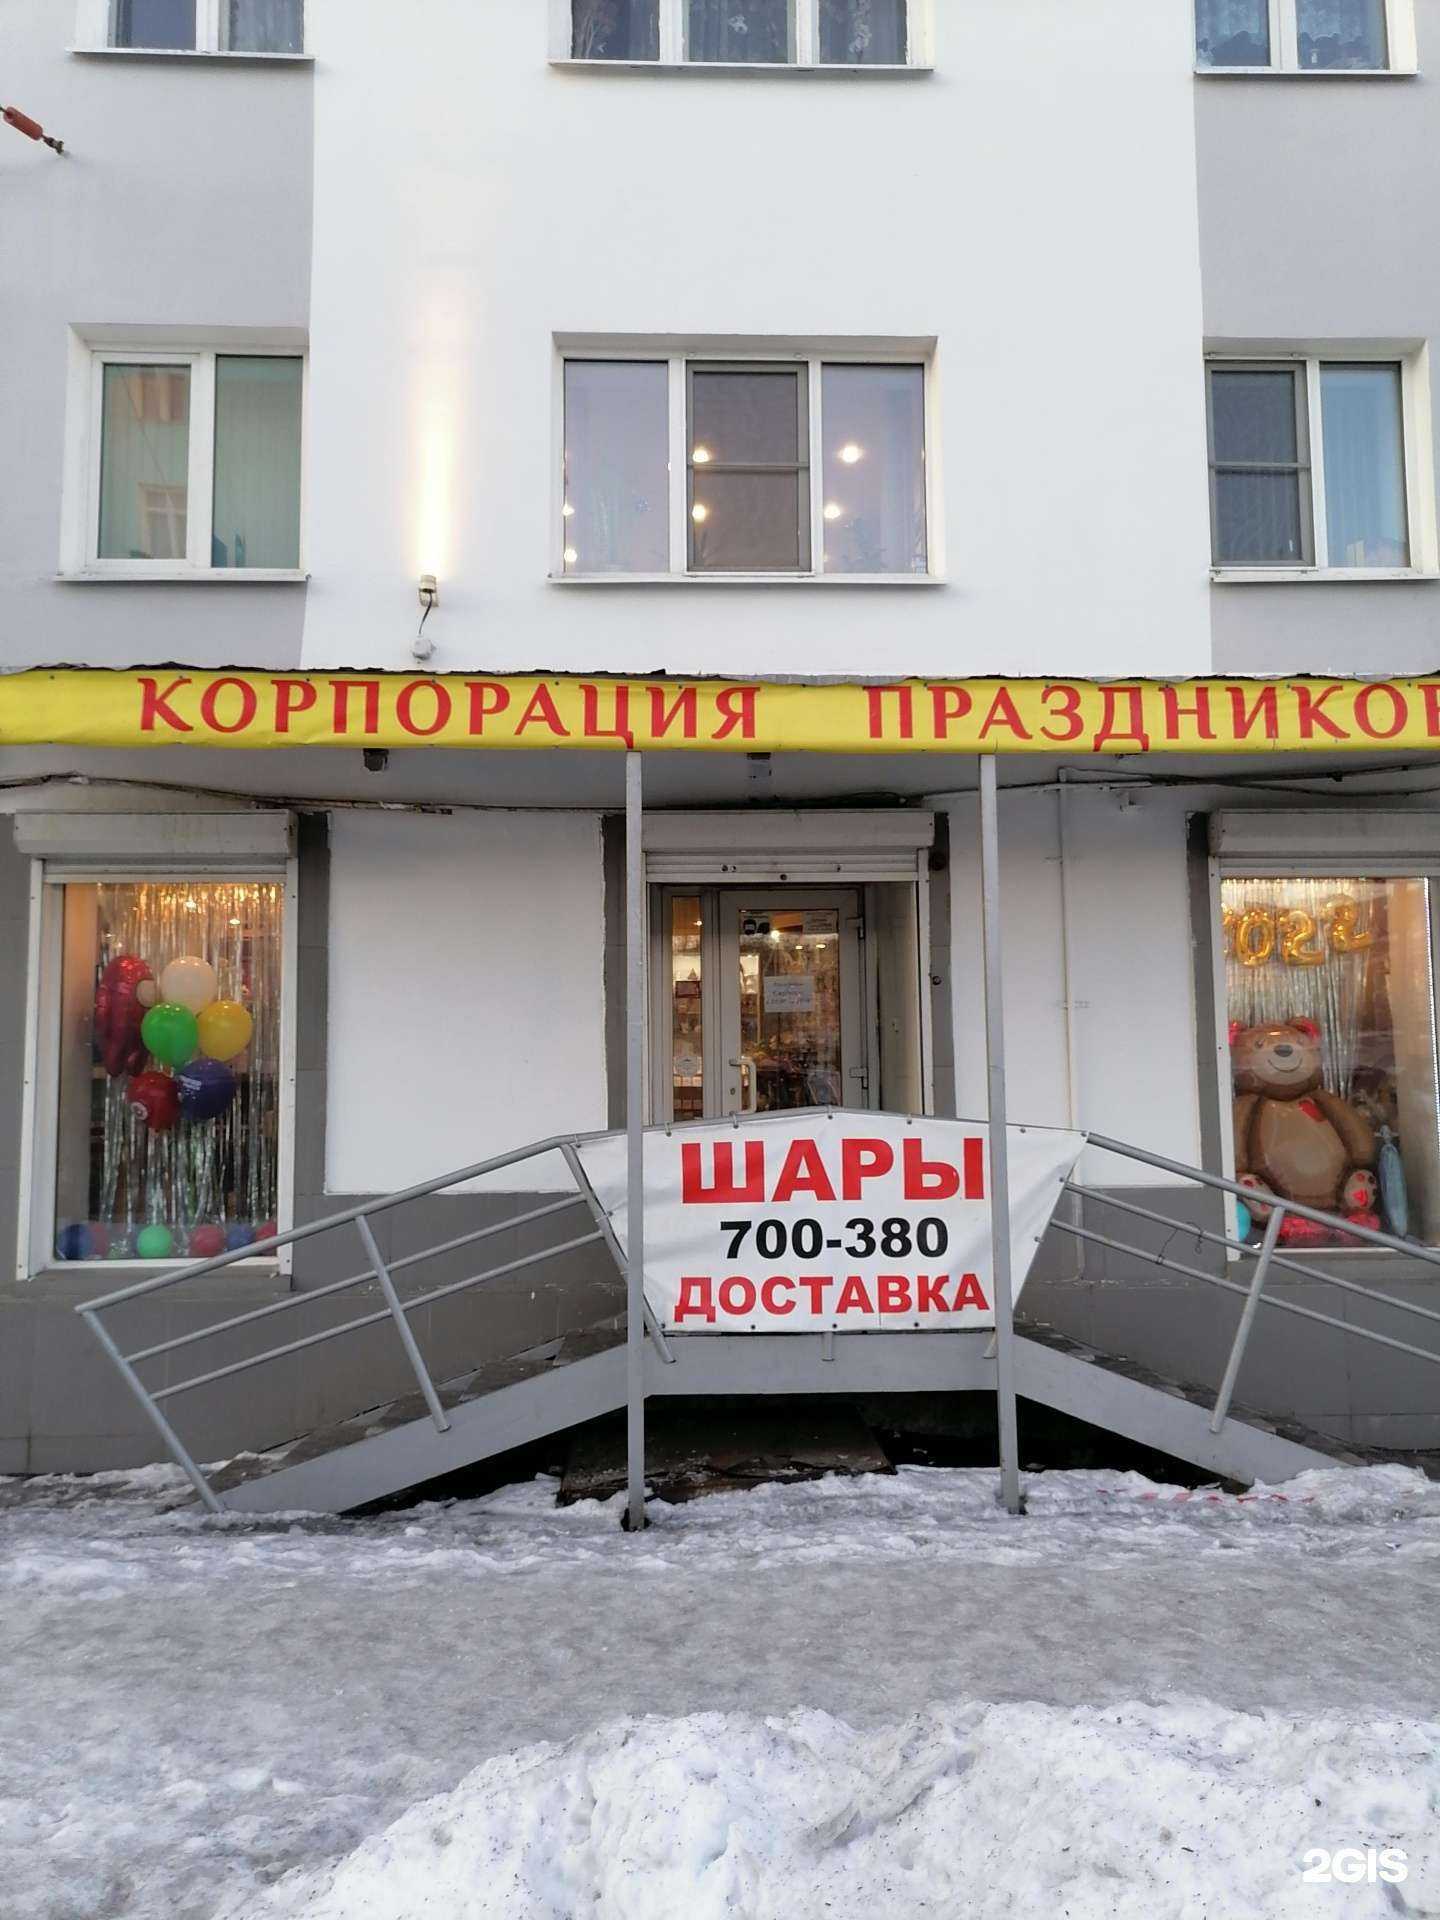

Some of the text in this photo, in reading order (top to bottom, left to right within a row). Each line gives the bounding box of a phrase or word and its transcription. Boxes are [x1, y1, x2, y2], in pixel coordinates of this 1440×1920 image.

[138, 678, 761, 749] КОРПОРАЦИЯ
[682, 1138, 984, 1203] ШАРЫ
[721, 1218, 948, 1259] 700-380
[674, 1273, 990, 1322] ДОСТАВКА
